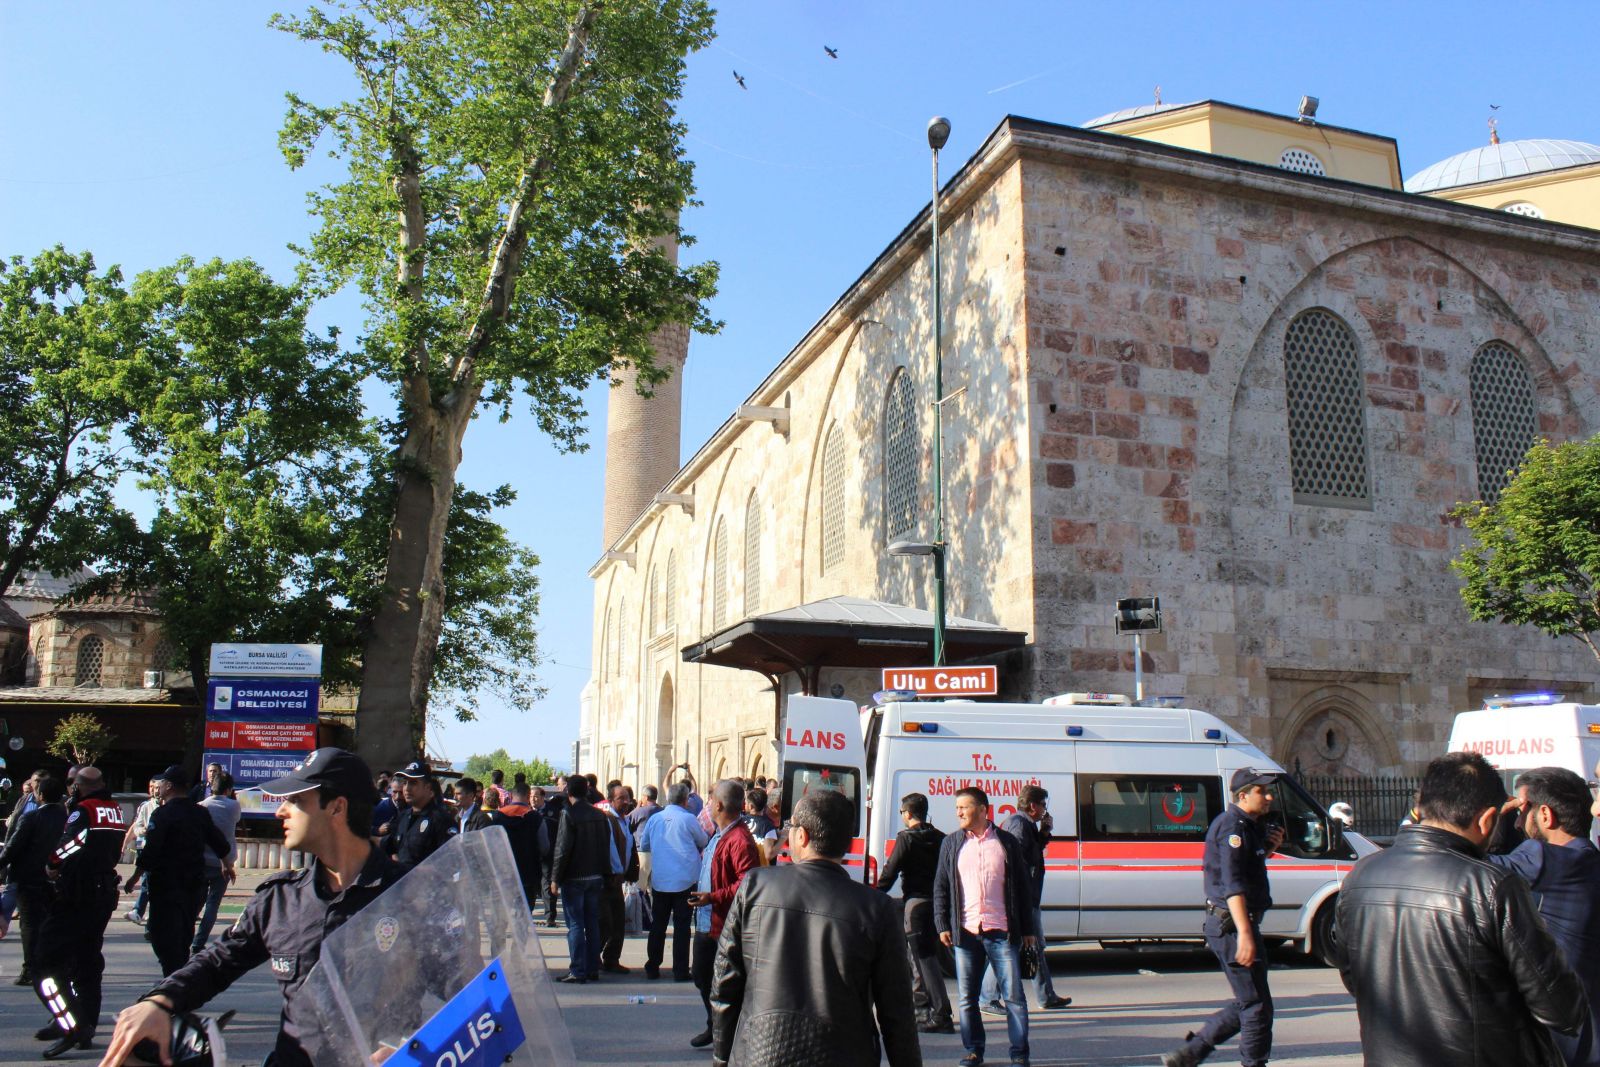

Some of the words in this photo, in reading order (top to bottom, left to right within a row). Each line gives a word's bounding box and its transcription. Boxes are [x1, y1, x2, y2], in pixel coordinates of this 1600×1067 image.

[893, 674, 926, 690] Ulu
[934, 672, 986, 689] Cami
[237, 690, 309, 698] OSMANGAZİ
[237, 700, 307, 708] BELEDİYESİ
[785, 727, 846, 751] LANS
[1462, 738, 1555, 756] AMBULANS
[971, 753, 997, 771] T.C.
